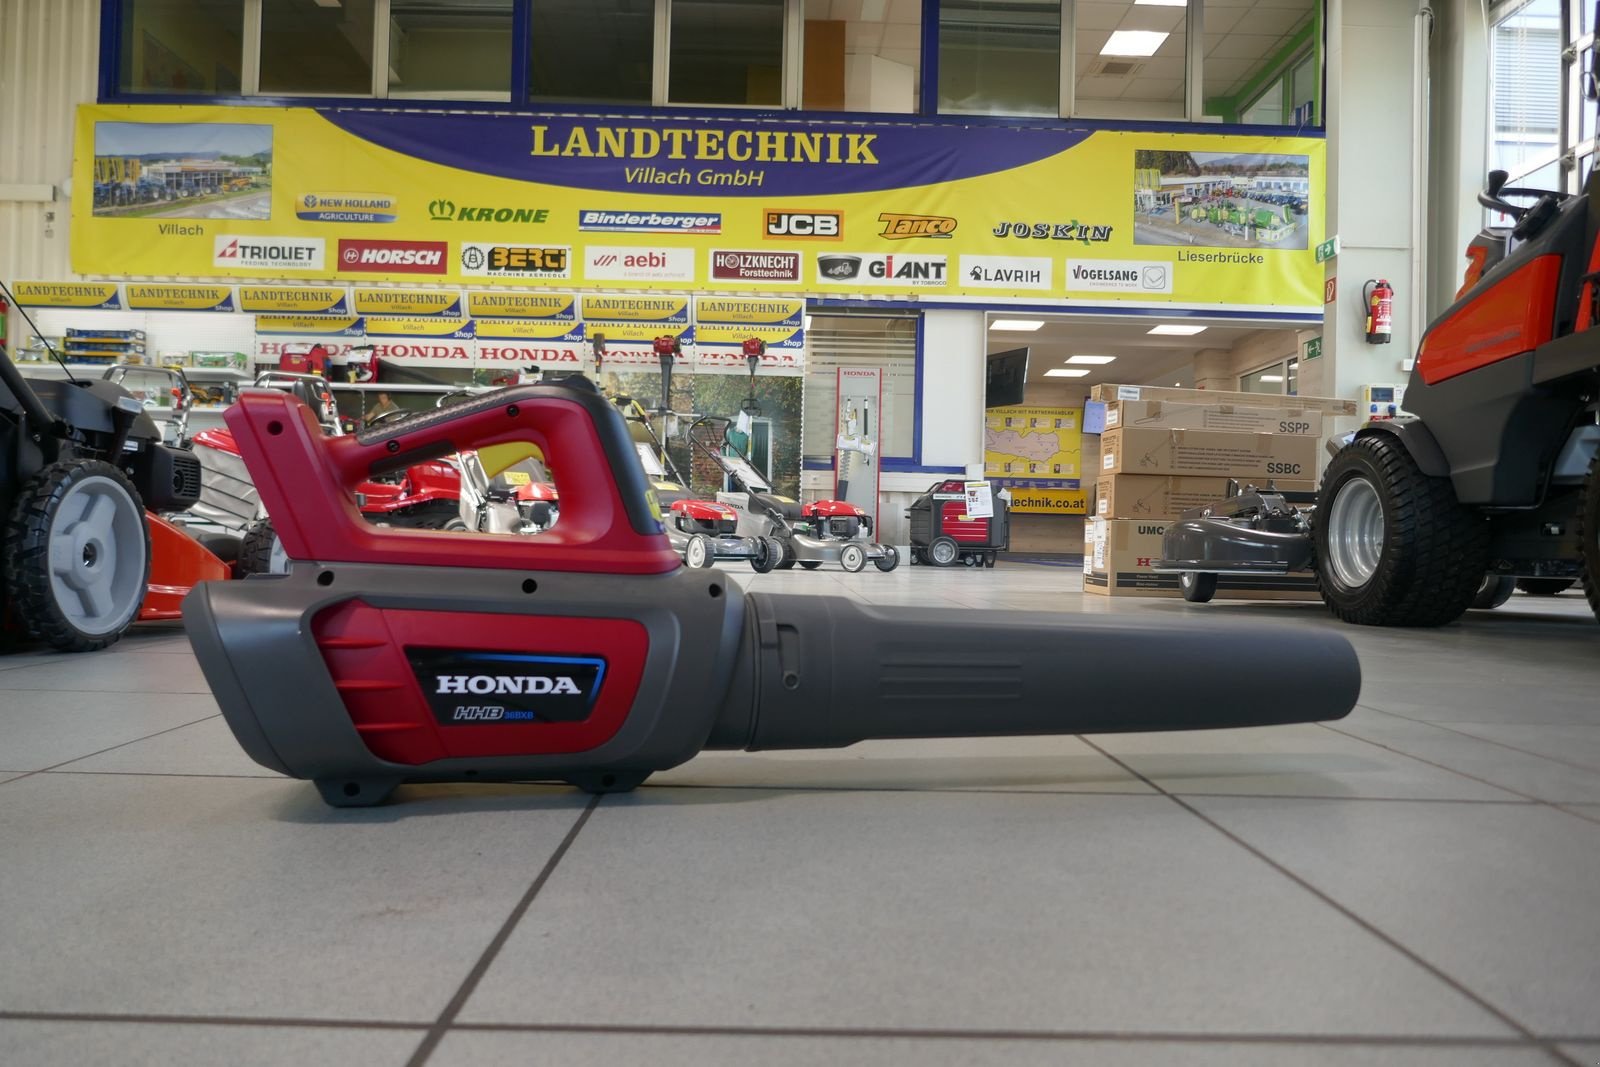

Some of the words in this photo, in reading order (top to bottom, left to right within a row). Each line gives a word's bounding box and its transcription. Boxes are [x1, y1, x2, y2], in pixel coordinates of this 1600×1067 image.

[531, 125, 879, 165] LANDTECHNIK
[625, 167, 691, 184] Villach
[697, 169, 764, 186] GmbH
[320, 198, 342, 208] NEW
[345, 199, 391, 209] HOLLAND
[319, 212, 374, 222] AGRICULTURE
[458, 207, 549, 223] KRONE
[584, 212, 718, 228] Binderberger
[159, 224, 204, 236] Villach
[768, 214, 838, 235] JCB
[878, 213, 957, 238] Tanco
[993, 221, 1113, 242] JOSKIN
[239, 245, 316, 261] TRIOLIET
[361, 249, 441, 265] HORSCH
[624, 252, 666, 268] aebi
[1178, 251, 1264, 264] Lieserbrücke
[716, 254, 795, 269] HOLZKNECHT
[740, 268, 793, 278] Forsttechnik
[984, 269, 1040, 283] LAVRIH
[1073, 265, 1138, 281] VOGELSANG
[17, 286, 106, 297] LANDTECHNIK
[131, 288, 219, 299] LANDTECHNIK
[244, 290, 333, 302] LANDTECHNIK
[359, 293, 448, 304] LANDTECHNIK
[473, 296, 561, 307] LANDTECHNIK
[586, 299, 675, 310] LANDTECHNIK
[701, 302, 789, 313] LANDTECHNIK
[783, 339, 802, 347] Shop
[374, 344, 469, 359] HONDA
[480, 347, 579, 362] HONDA
[1279, 421, 1309, 433] SSPP
[1266, 462, 1301, 474] SSBC
[436, 676, 581, 694] HONDA
